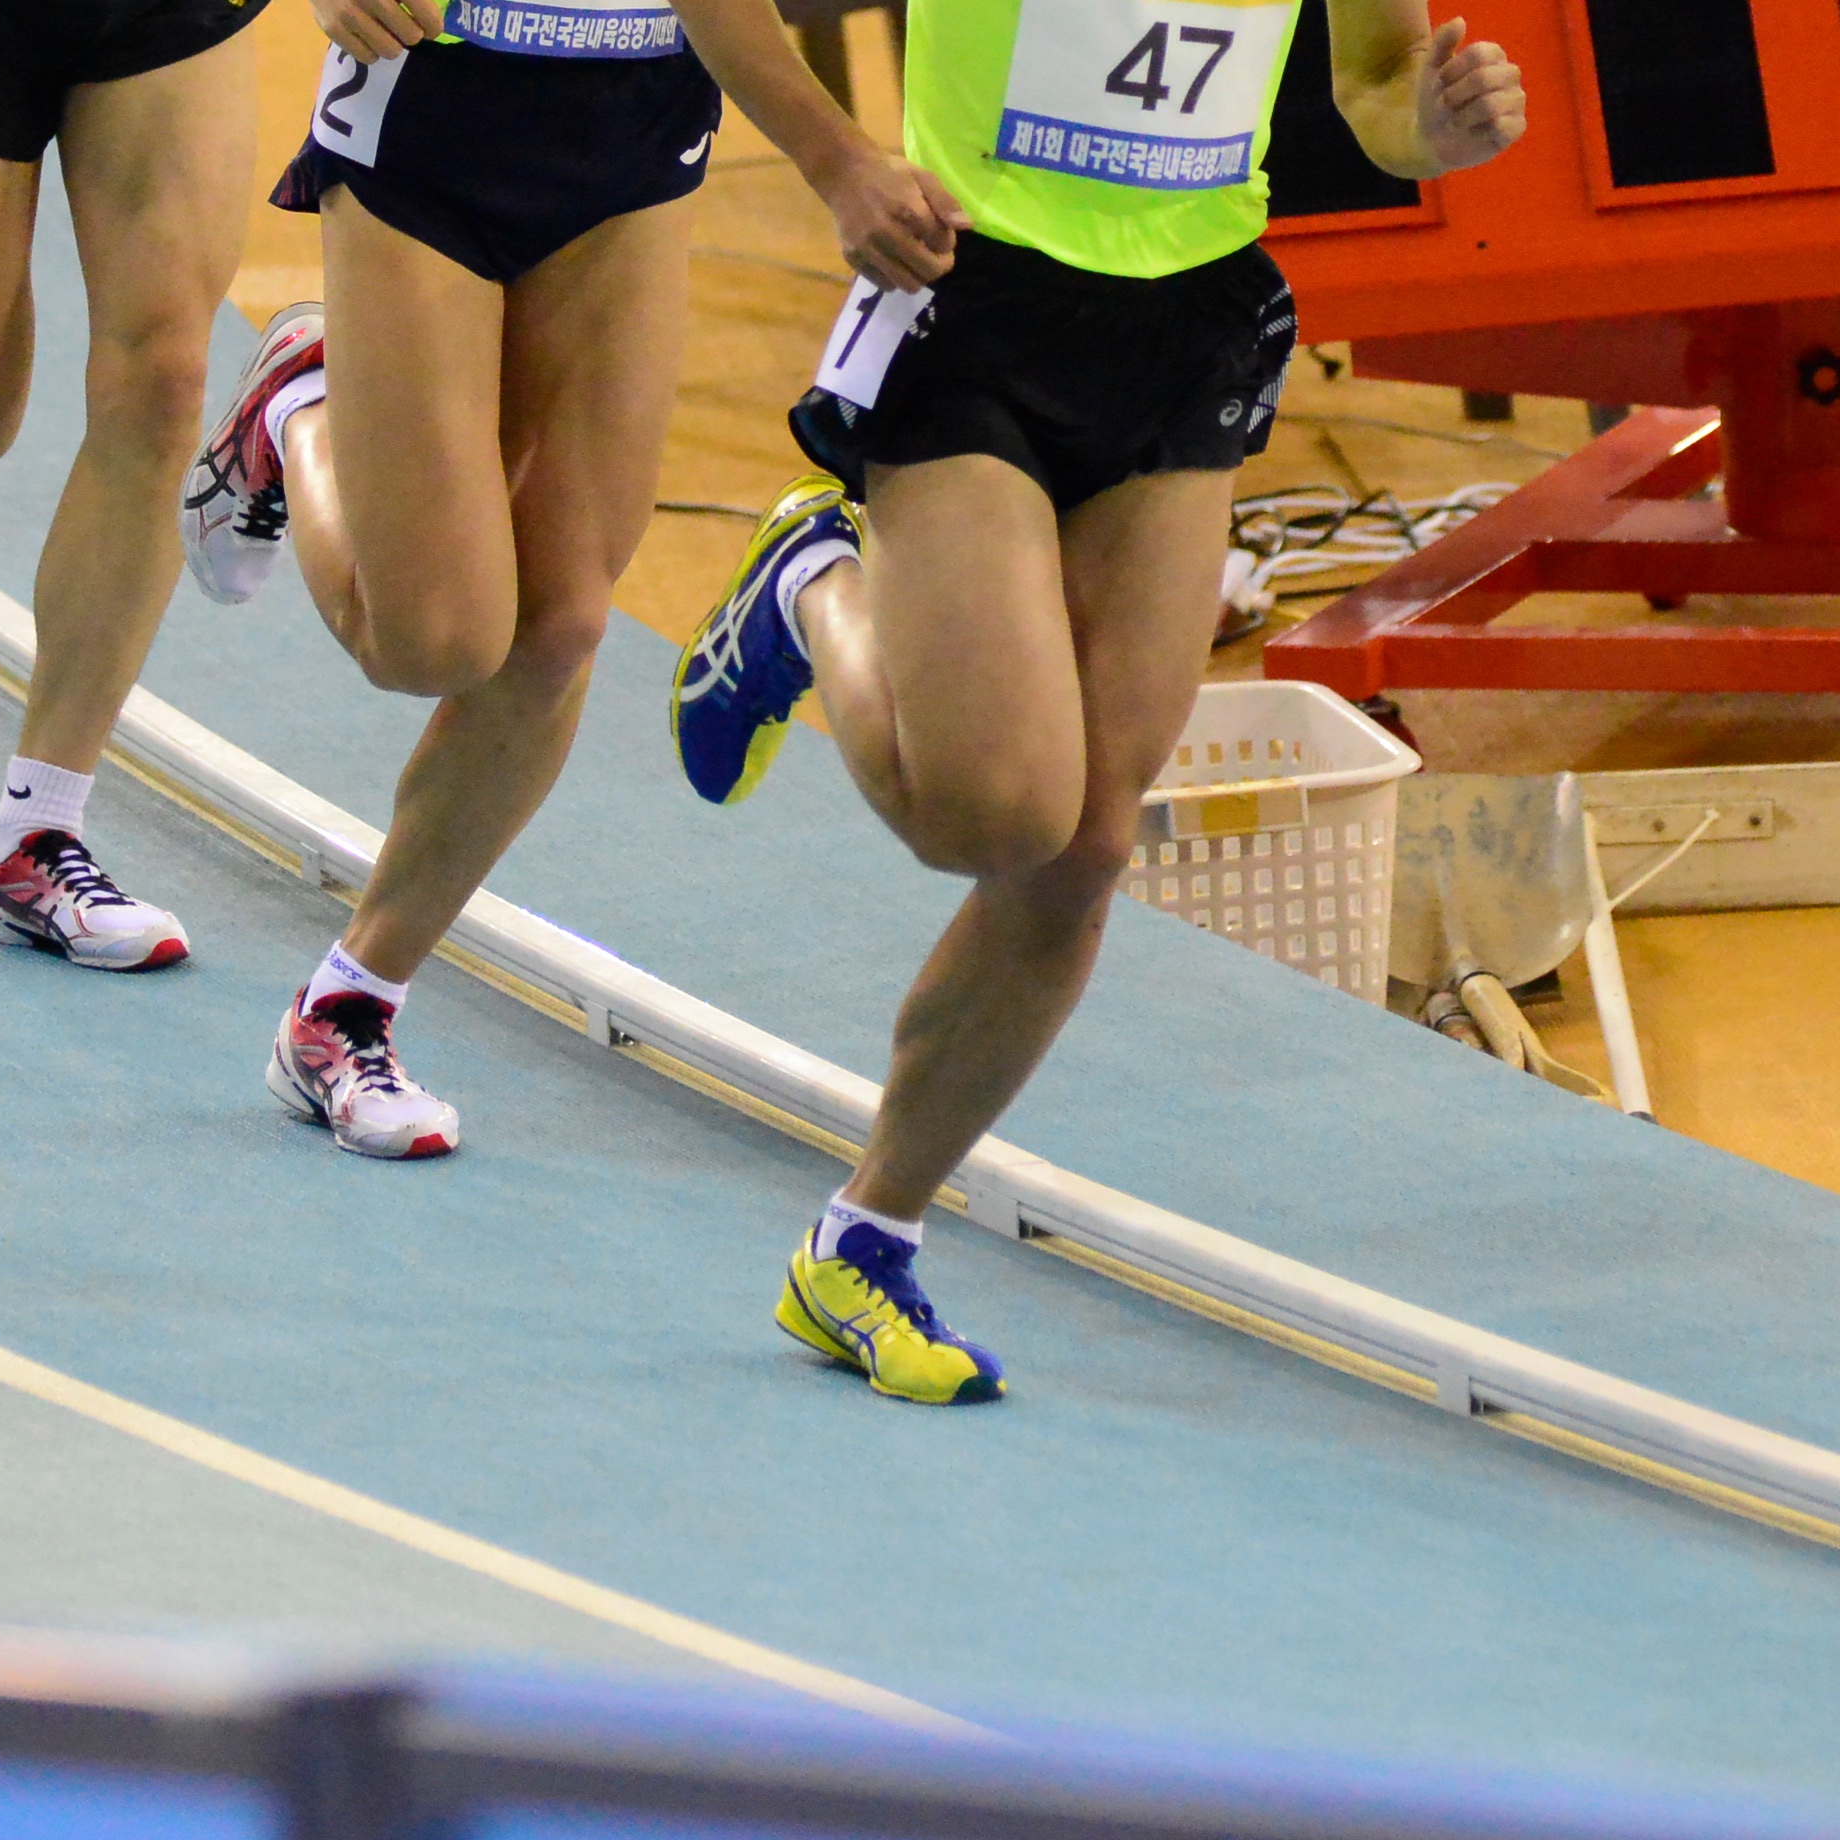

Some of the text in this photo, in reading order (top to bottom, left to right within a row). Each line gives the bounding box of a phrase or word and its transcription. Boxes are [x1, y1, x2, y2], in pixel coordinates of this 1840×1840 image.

[504, 10, 678, 50] 대구전국실내육상경기대회
[1105, 22, 1235, 114] 47
[319, 49, 369, 139] 2
[1011, 120, 1066, 162] 제1회
[834, 290, 884, 370] 1
